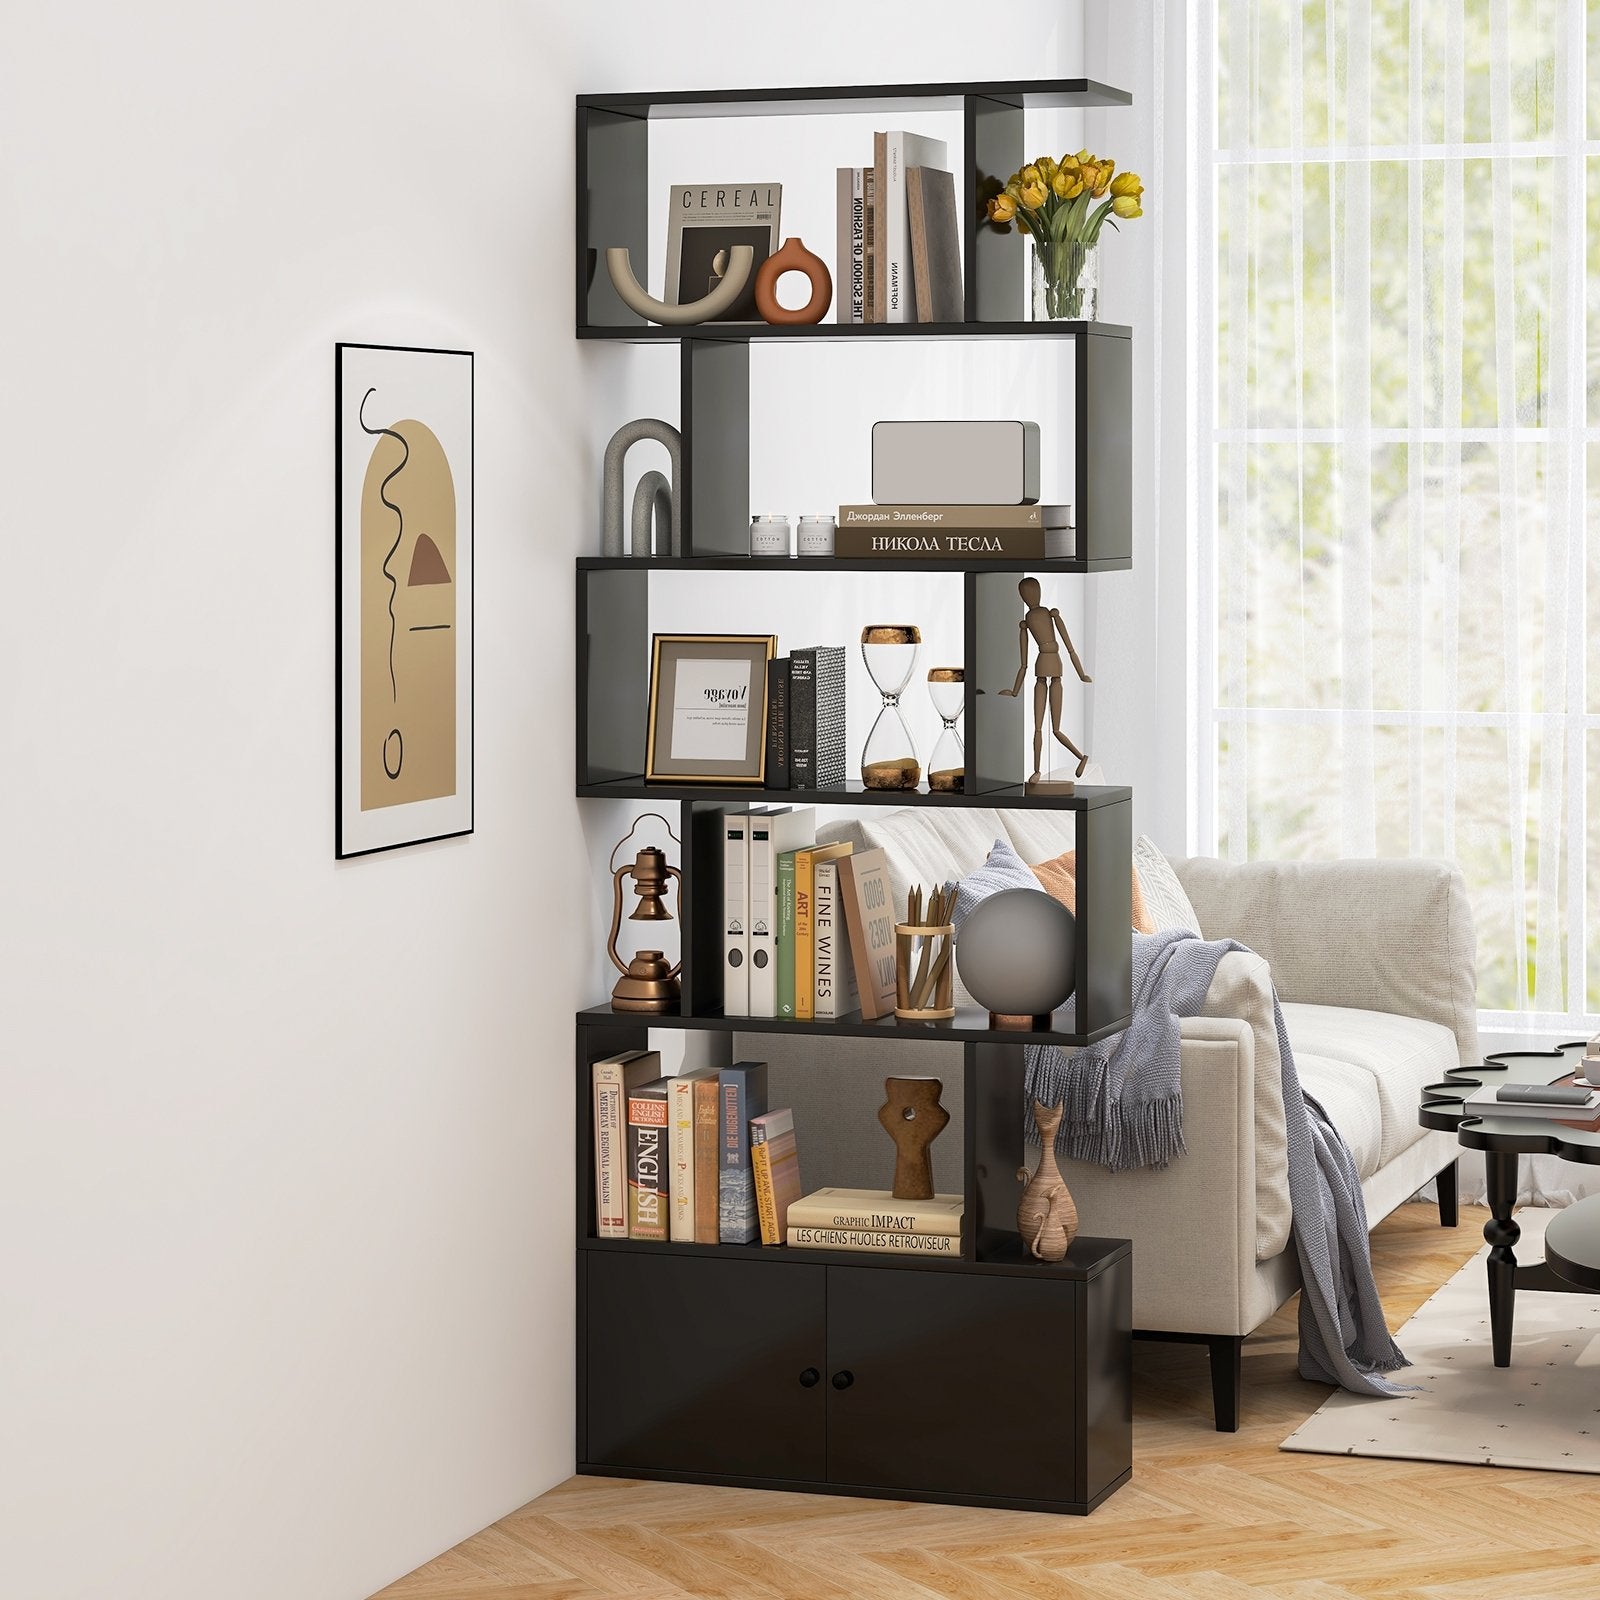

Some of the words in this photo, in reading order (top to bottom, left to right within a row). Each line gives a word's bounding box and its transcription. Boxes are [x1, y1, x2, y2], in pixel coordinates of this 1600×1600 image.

[682, 189, 774, 208] CEREAL
[846, 511, 890, 522] Джордан
[893, 512, 944, 522] Элленберг
[871, 536, 940, 551] НИКОЛА
[945, 536, 1003, 551] ТЕСЛА
[797, 892, 808, 918] ART
[818, 886, 831, 927] FINE
[818, 936, 831, 998] WINES
[600, 1090, 610, 1128] AMERICAN
[632, 1103, 665, 1111] COLLINS
[632, 1109, 664, 1118] ENGLISH
[600, 1131, 610, 1168] REGIONAL
[727, 1137, 738, 1148] DIE
[601, 1171, 610, 1204] ENGLISH
[638, 1128, 659, 1224] ENGLISH
[760, 1169, 768, 1180] UP
[764, 1197, 774, 1220] START
[833, 1215, 870, 1227] GRAPHIC
[871, 1214, 916, 1230] IMPACT
[797, 1229, 812, 1243] LES
[814, 1230, 847, 1244] CHIENS
[850, 1232, 886, 1246] HUOLES
[889, 1235, 950, 1250] RETROVISEUR
